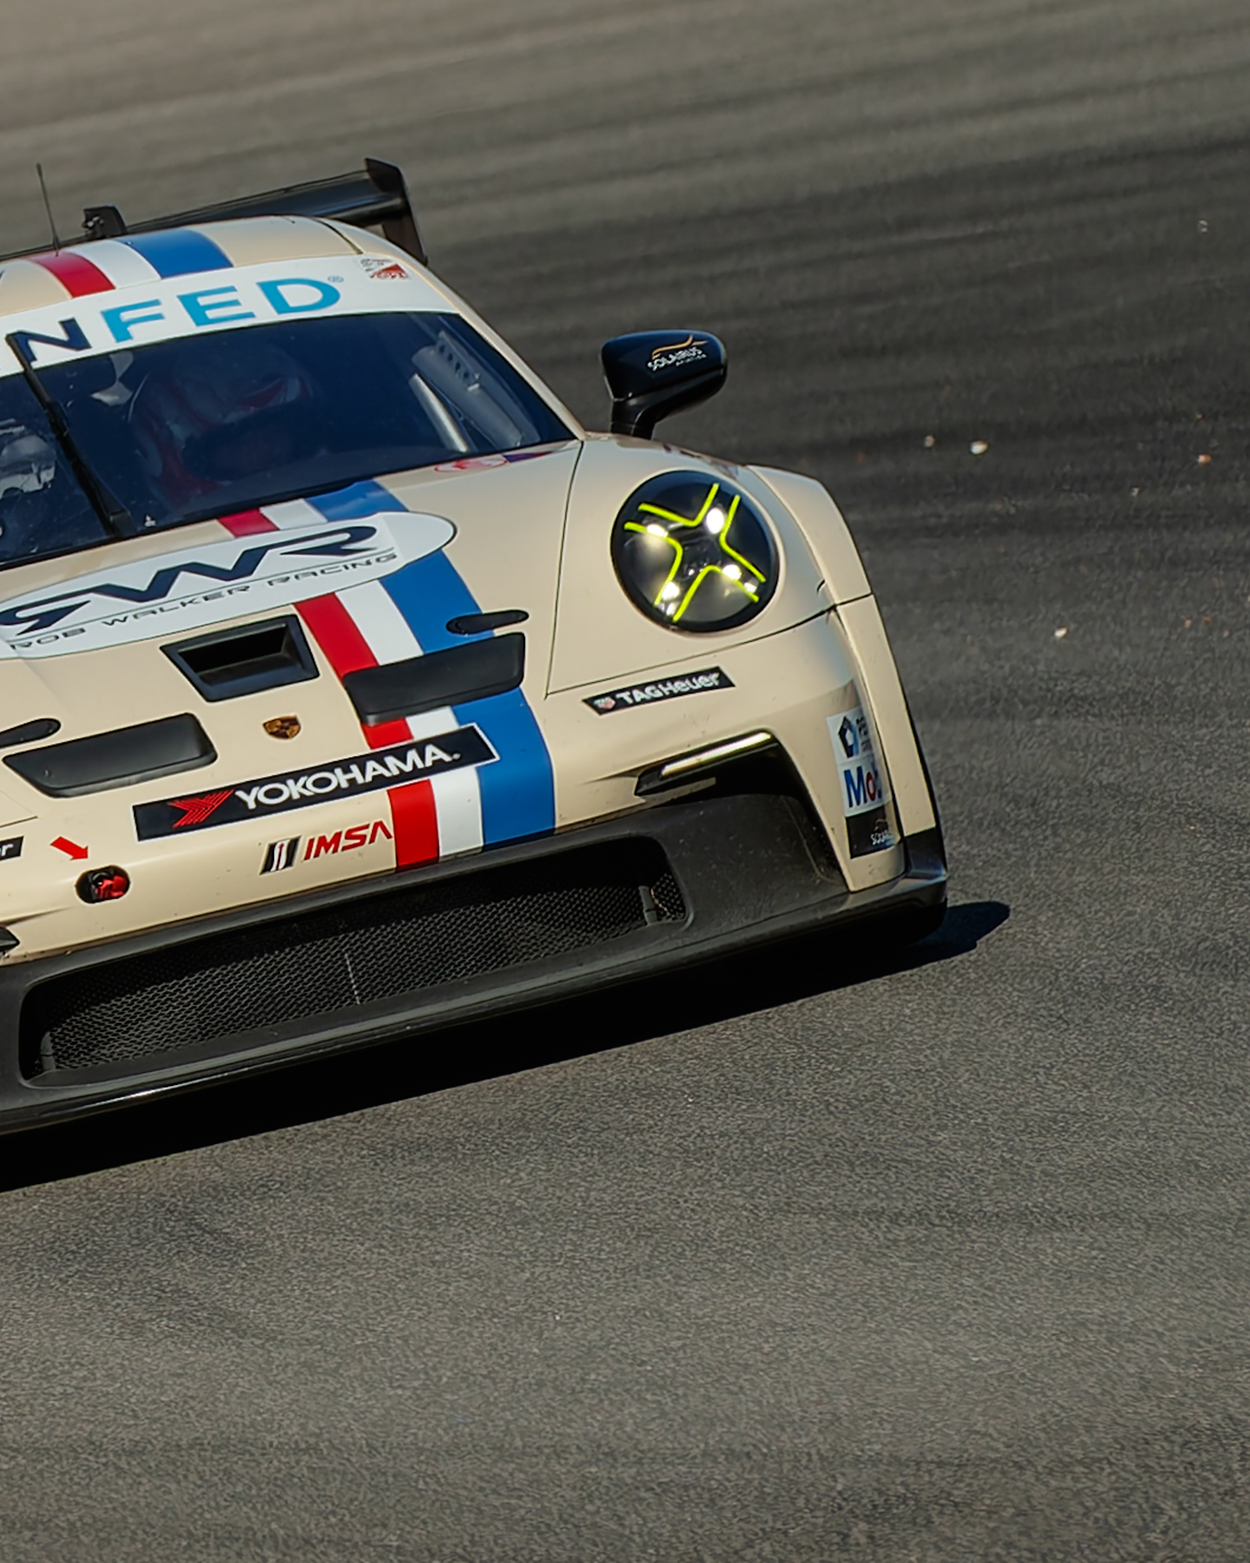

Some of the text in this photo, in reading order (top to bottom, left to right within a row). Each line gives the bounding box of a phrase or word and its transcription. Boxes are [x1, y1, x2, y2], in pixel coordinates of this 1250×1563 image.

[10, 552, 398, 650] ROB WALKER RACING
[235, 744, 454, 810] YOKOHAMA
[303, 820, 394, 861] IMSA
